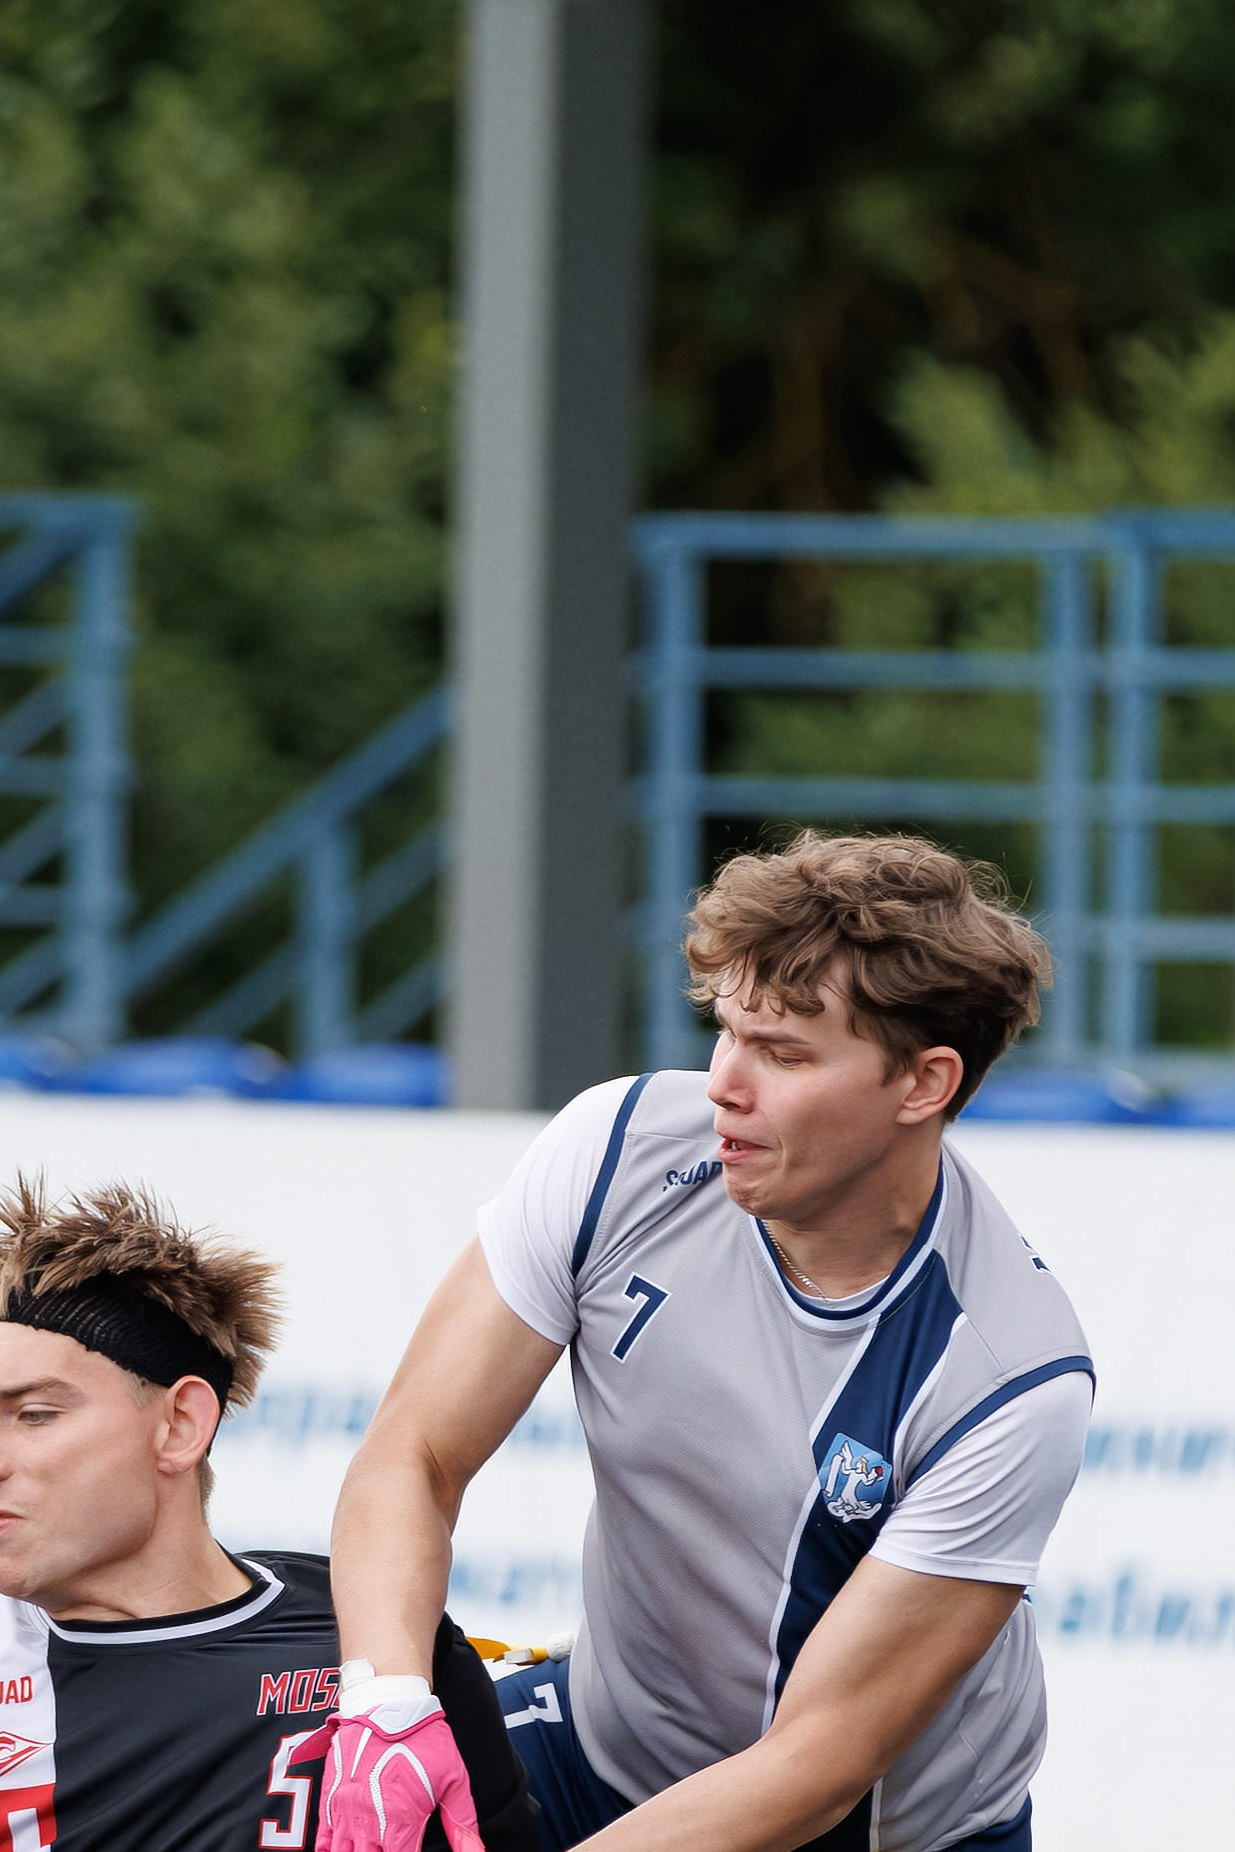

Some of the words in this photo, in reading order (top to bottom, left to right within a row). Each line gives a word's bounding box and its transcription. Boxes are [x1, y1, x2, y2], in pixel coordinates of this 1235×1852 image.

[611, 1272, 672, 1364] 7
[256, 1666, 340, 1716] MOS
[259, 1728, 323, 1848] 5
